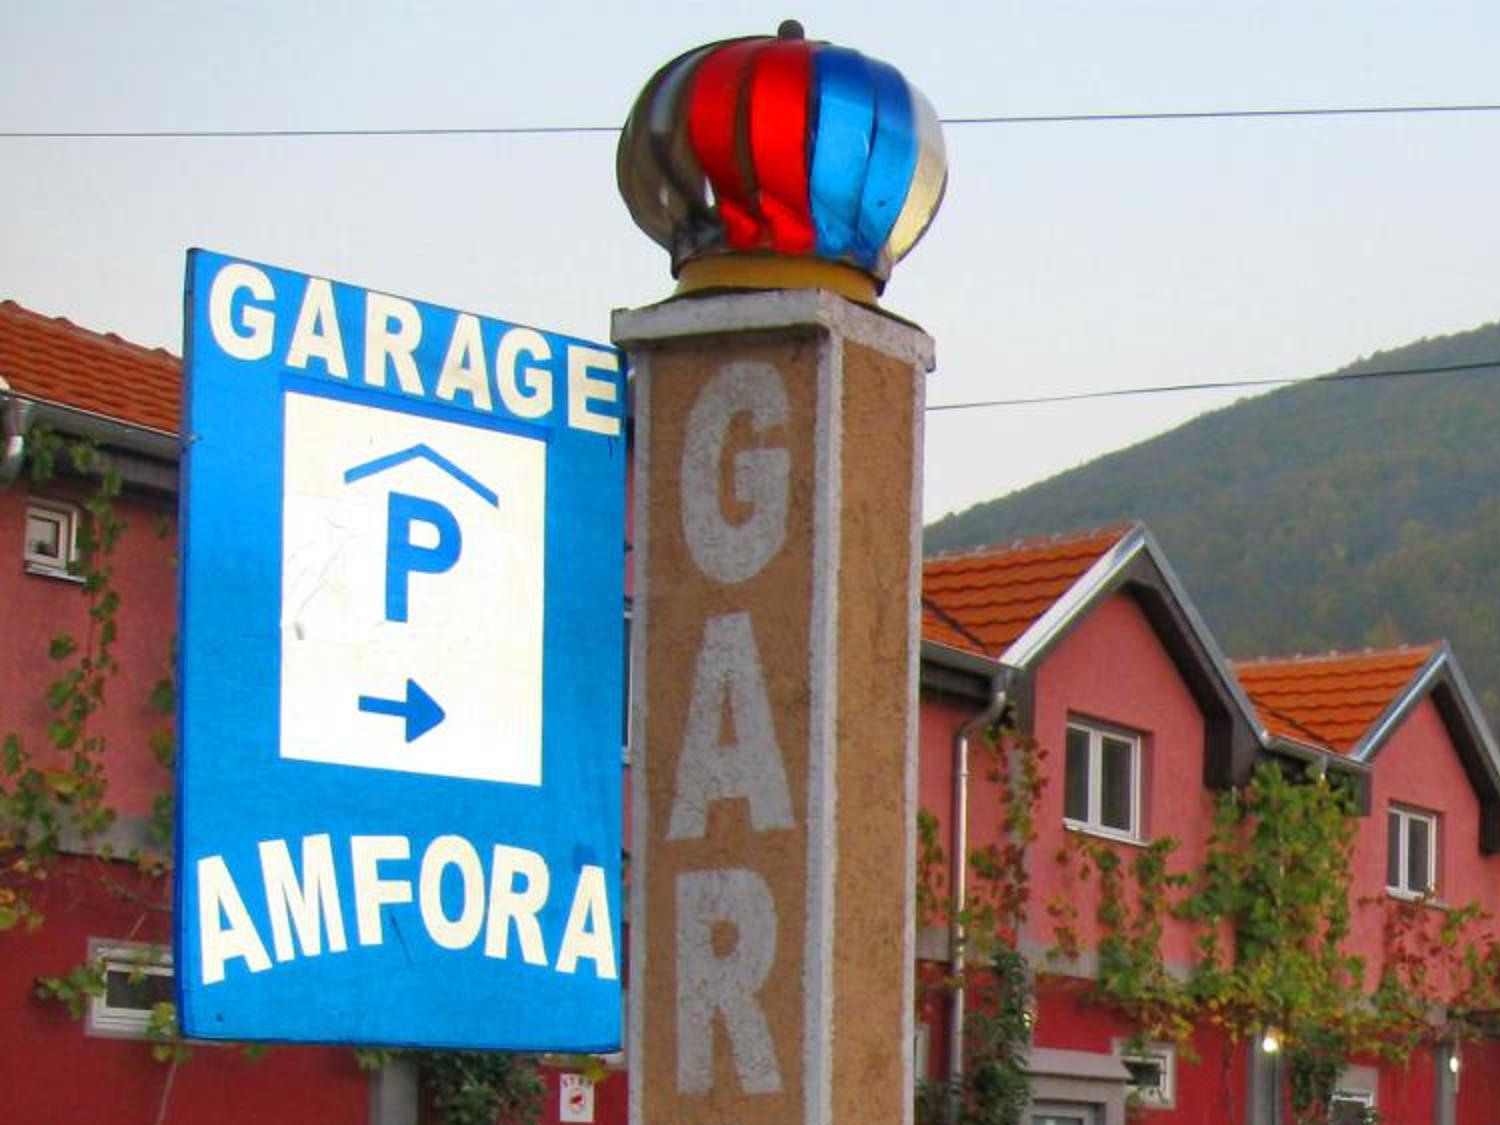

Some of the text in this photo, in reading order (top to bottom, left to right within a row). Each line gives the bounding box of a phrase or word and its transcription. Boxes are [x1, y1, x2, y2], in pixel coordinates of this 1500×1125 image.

[208, 263, 621, 437] GARAGE
[384, 490, 463, 623] P
[196, 832, 618, 986] AMFORA
